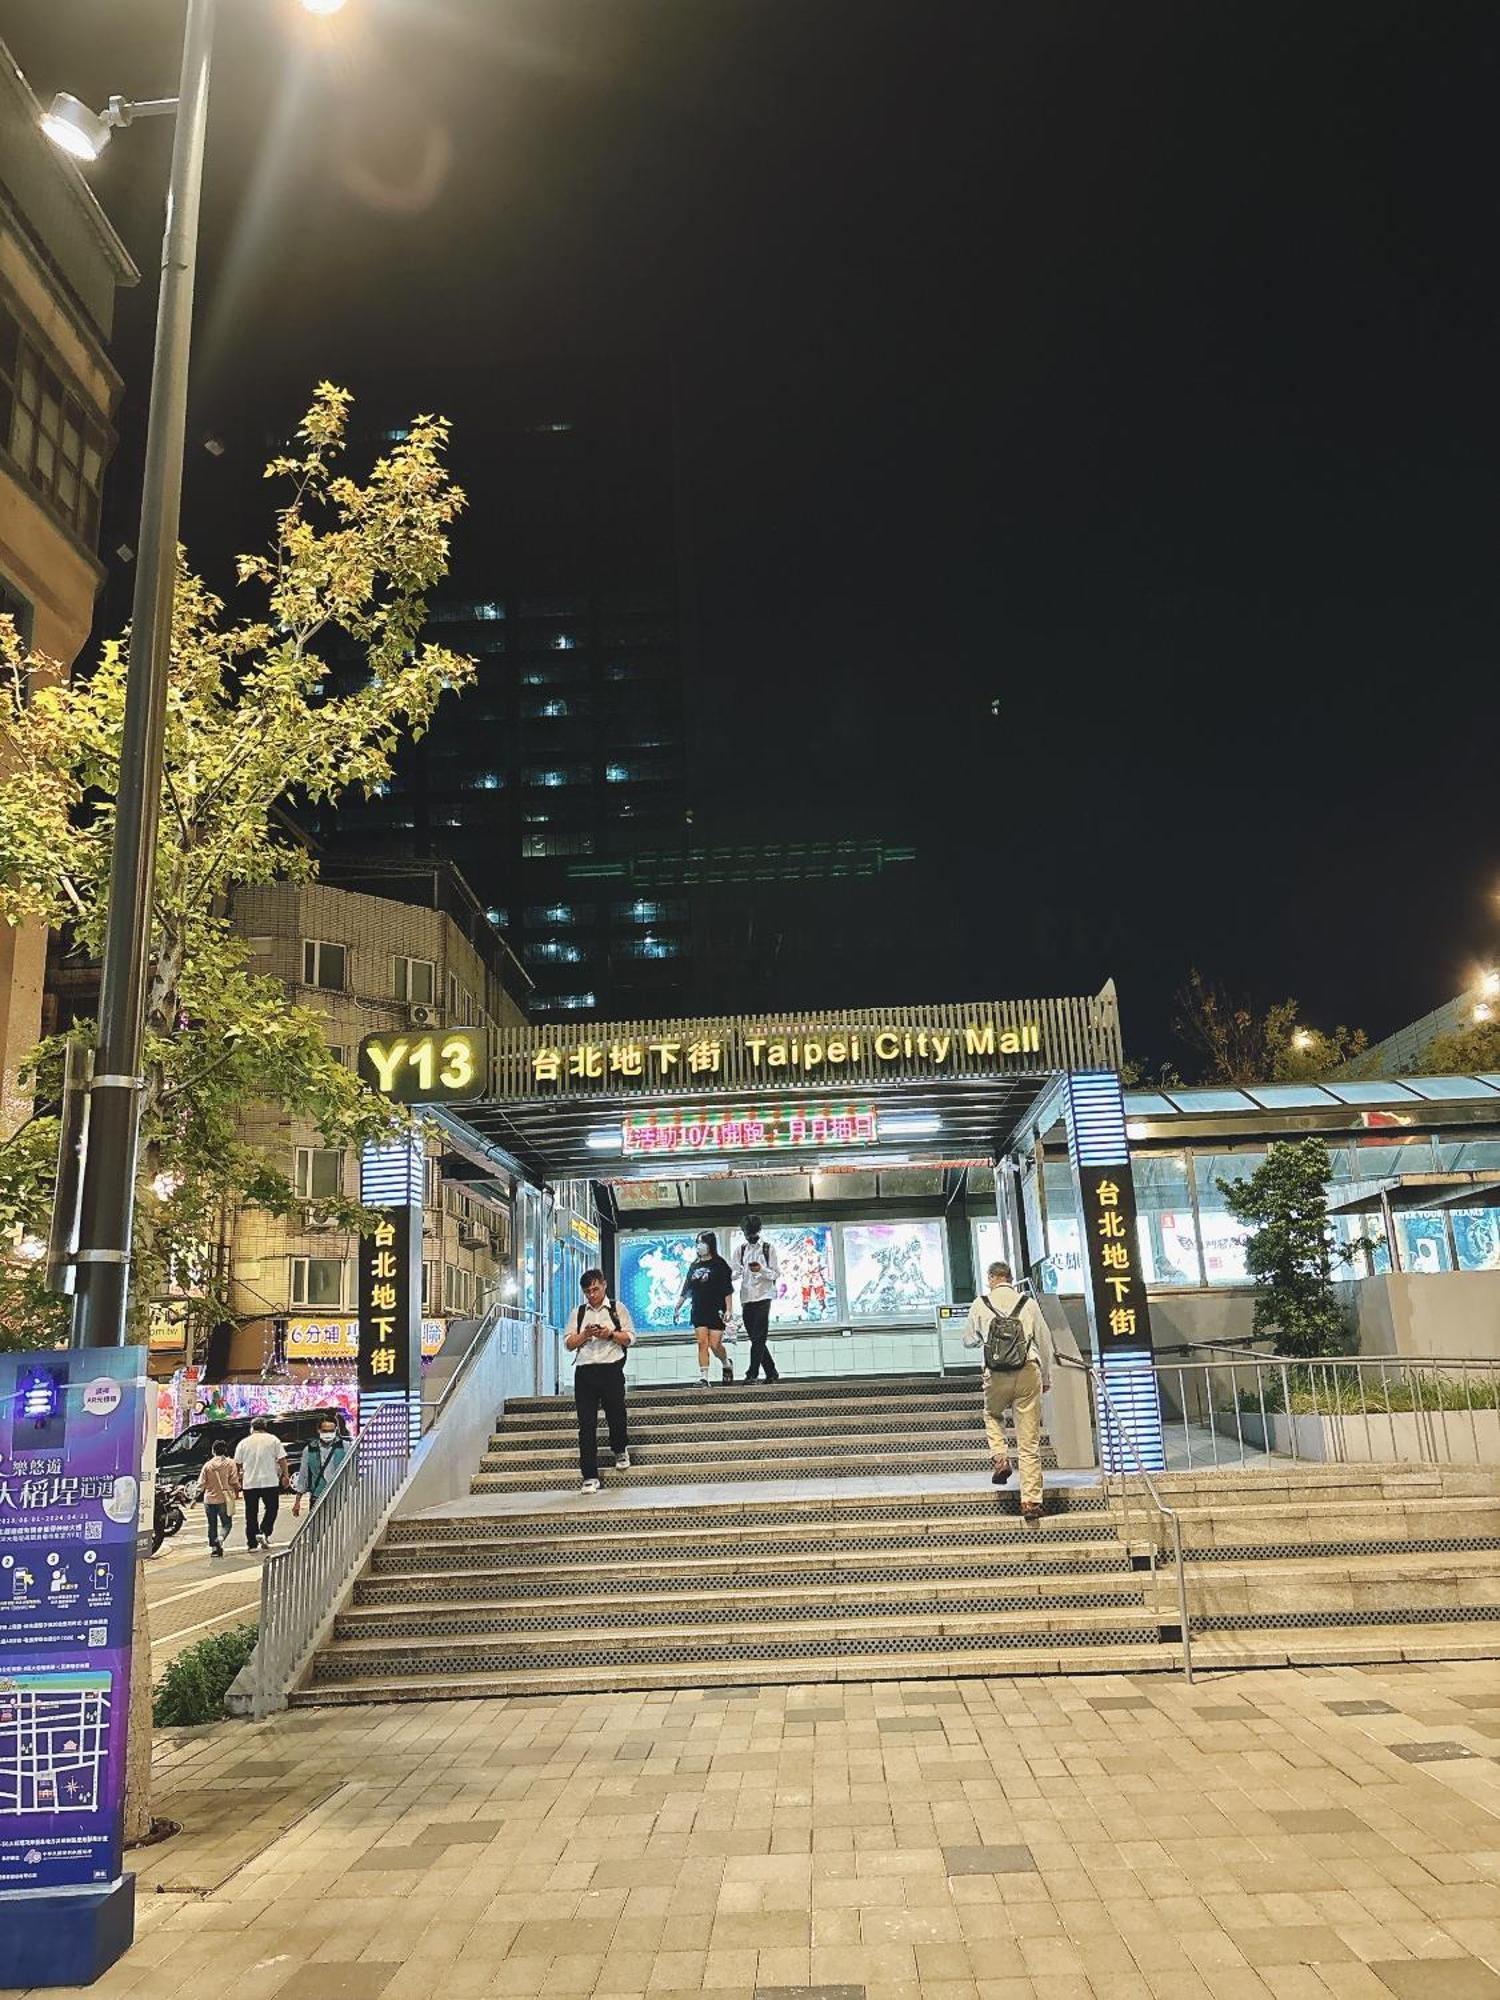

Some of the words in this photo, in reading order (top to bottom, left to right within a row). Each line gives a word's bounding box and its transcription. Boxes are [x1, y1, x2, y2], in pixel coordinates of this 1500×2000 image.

[366, 1041, 473, 1092] Y13
[532, 1039, 721, 1082] 台北地下街
[745, 1034, 860, 1071] Taipei
[873, 1031, 951, 1064] City
[966, 1025, 1041, 1057] Mall
[1096, 1180, 1137, 1336] 台北地下街
[371, 1221, 397, 1376] 台北地下街
[291, 1324, 340, 1345] 6分埔
[0, 1477, 80, 1510] 大稻埕
